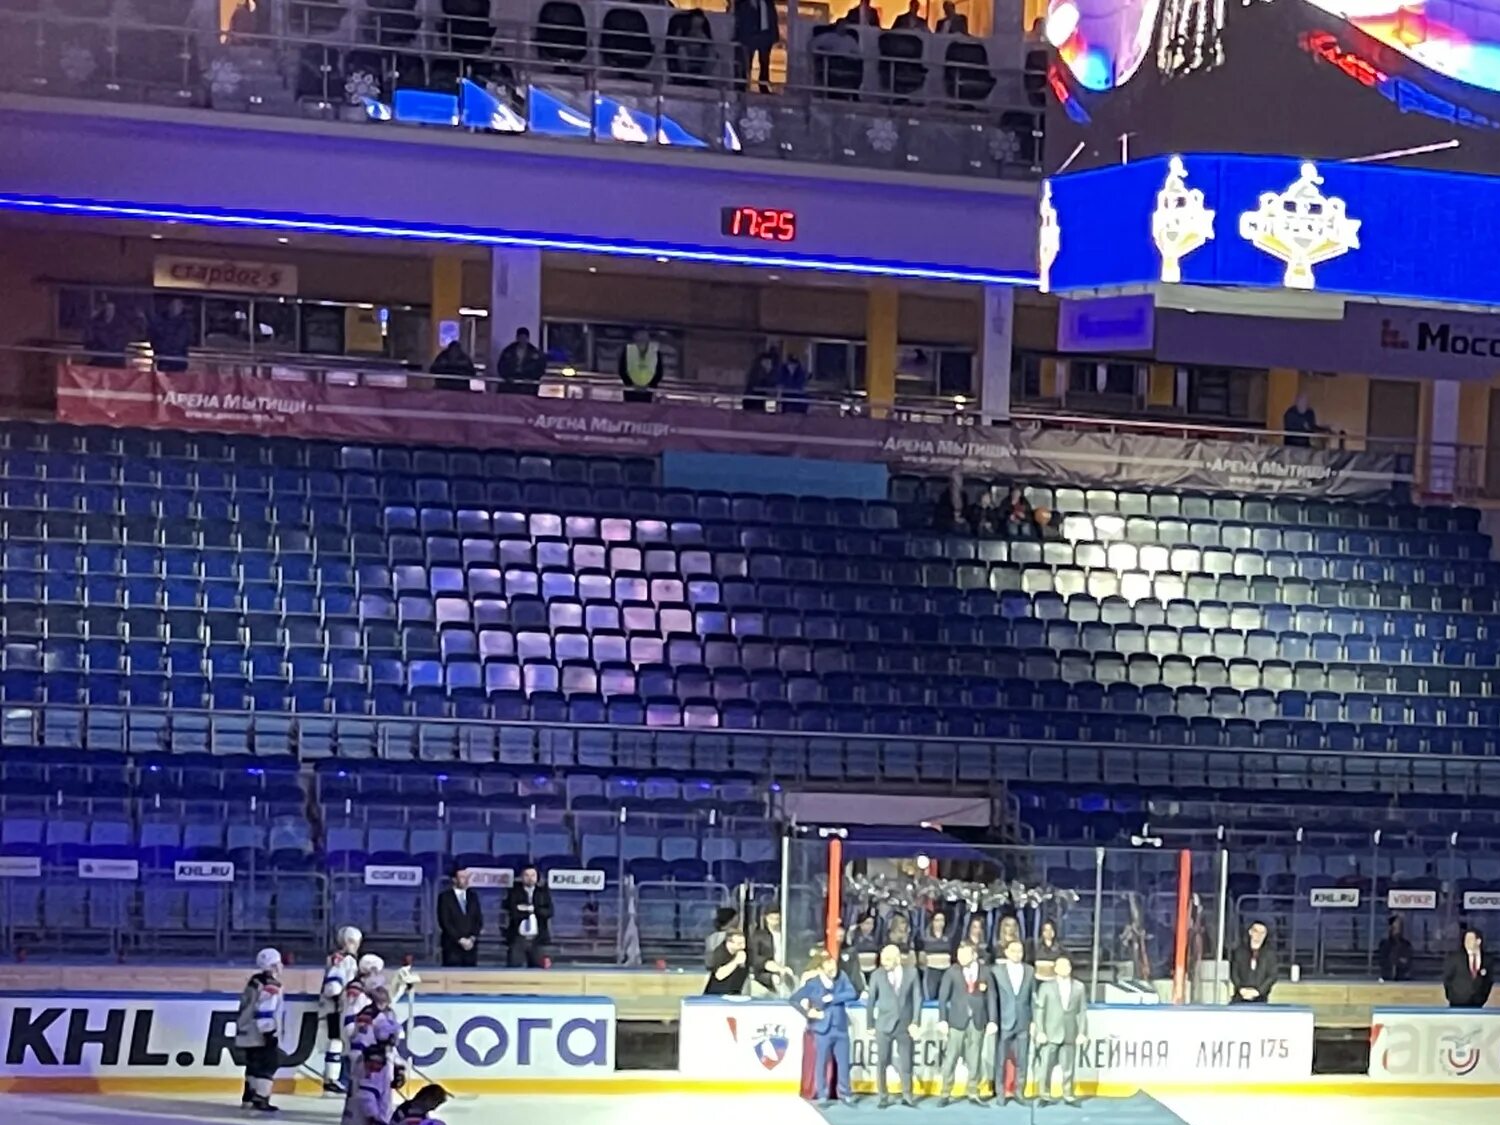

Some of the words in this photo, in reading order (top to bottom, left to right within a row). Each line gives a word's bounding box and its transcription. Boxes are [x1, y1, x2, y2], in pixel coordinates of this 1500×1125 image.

[732, 207, 796, 241] 17:25
[163, 390, 219, 409] АРЕНА
[223, 393, 306, 415] МЫТИЩИ
[533, 414, 587, 431] АРЕНА
[883, 436, 934, 454] АРЕНА
[1211, 457, 1258, 474] АРЕНА
[552, 874, 601, 885] KHL.RU
[1313, 892, 1356, 903] KHL.RU
[1195, 1040, 1251, 1070] ЛИГА
